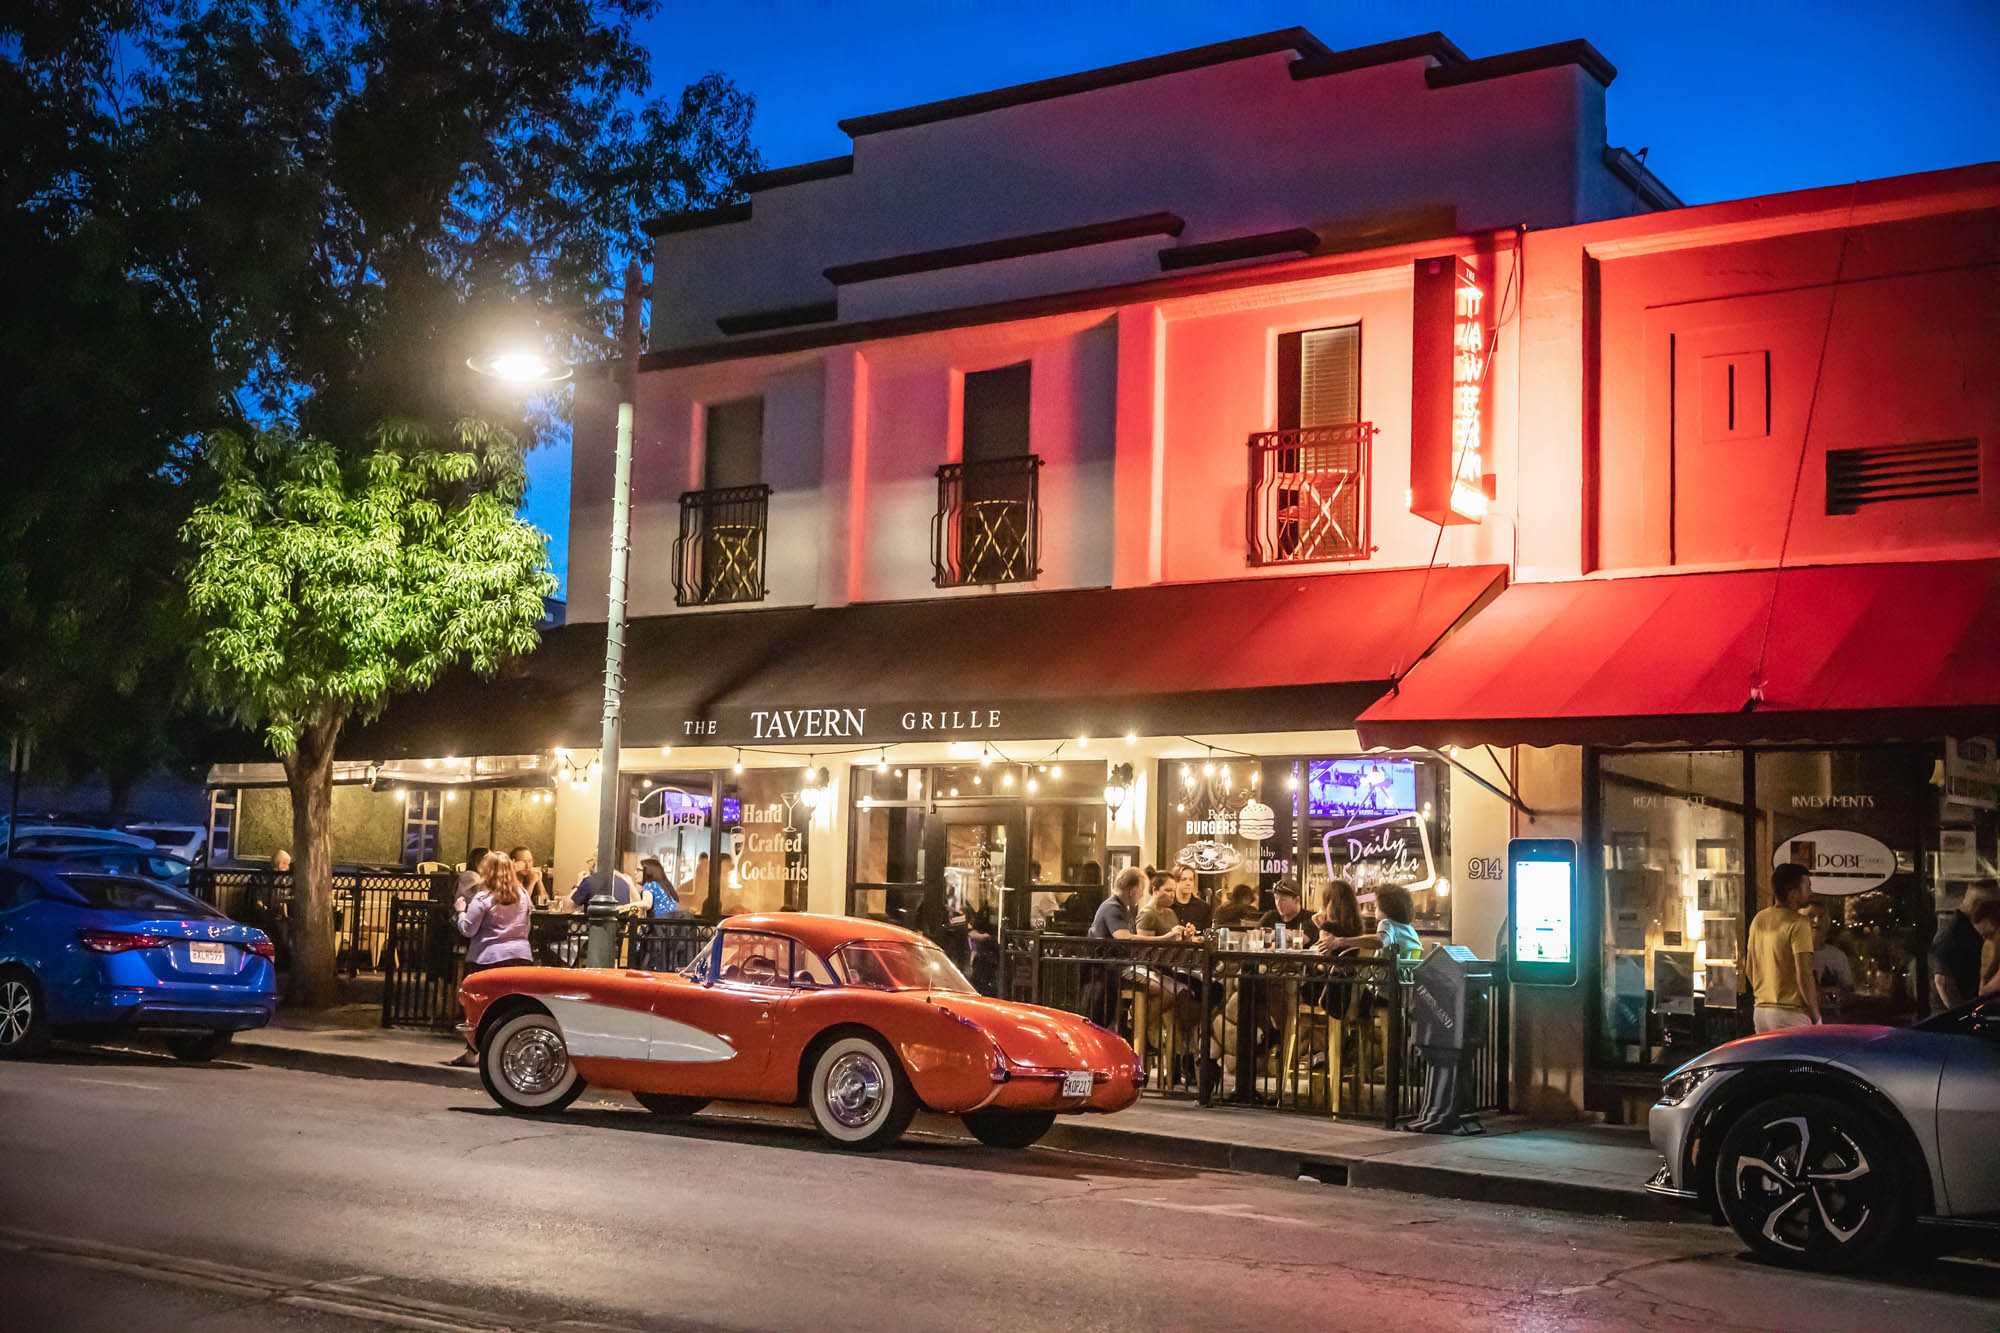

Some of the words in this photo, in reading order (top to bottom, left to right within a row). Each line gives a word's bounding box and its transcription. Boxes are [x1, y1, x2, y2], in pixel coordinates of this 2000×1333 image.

[1454, 290, 1482, 482] TAVERN
[684, 720, 717, 735] THE
[750, 708, 866, 739] TAVERN
[902, 710, 1001, 731] GRILLE
[1633, 796, 1657, 808] REAL
[1791, 795, 1874, 808] INVESTMENTS
[743, 804, 783, 824] Hand
[1208, 808, 1237, 820] Perfect
[1186, 820, 1237, 835] BURGERS
[748, 833, 802, 852] Crafted
[1347, 828, 1406, 862] Daily
[1245, 846, 1275, 859] Healthy
[741, 860, 809, 881] Cocktails
[1246, 859, 1289, 874] SALADS
[1343, 849, 1419, 893] Sials
[1468, 857, 1503, 880] 914
